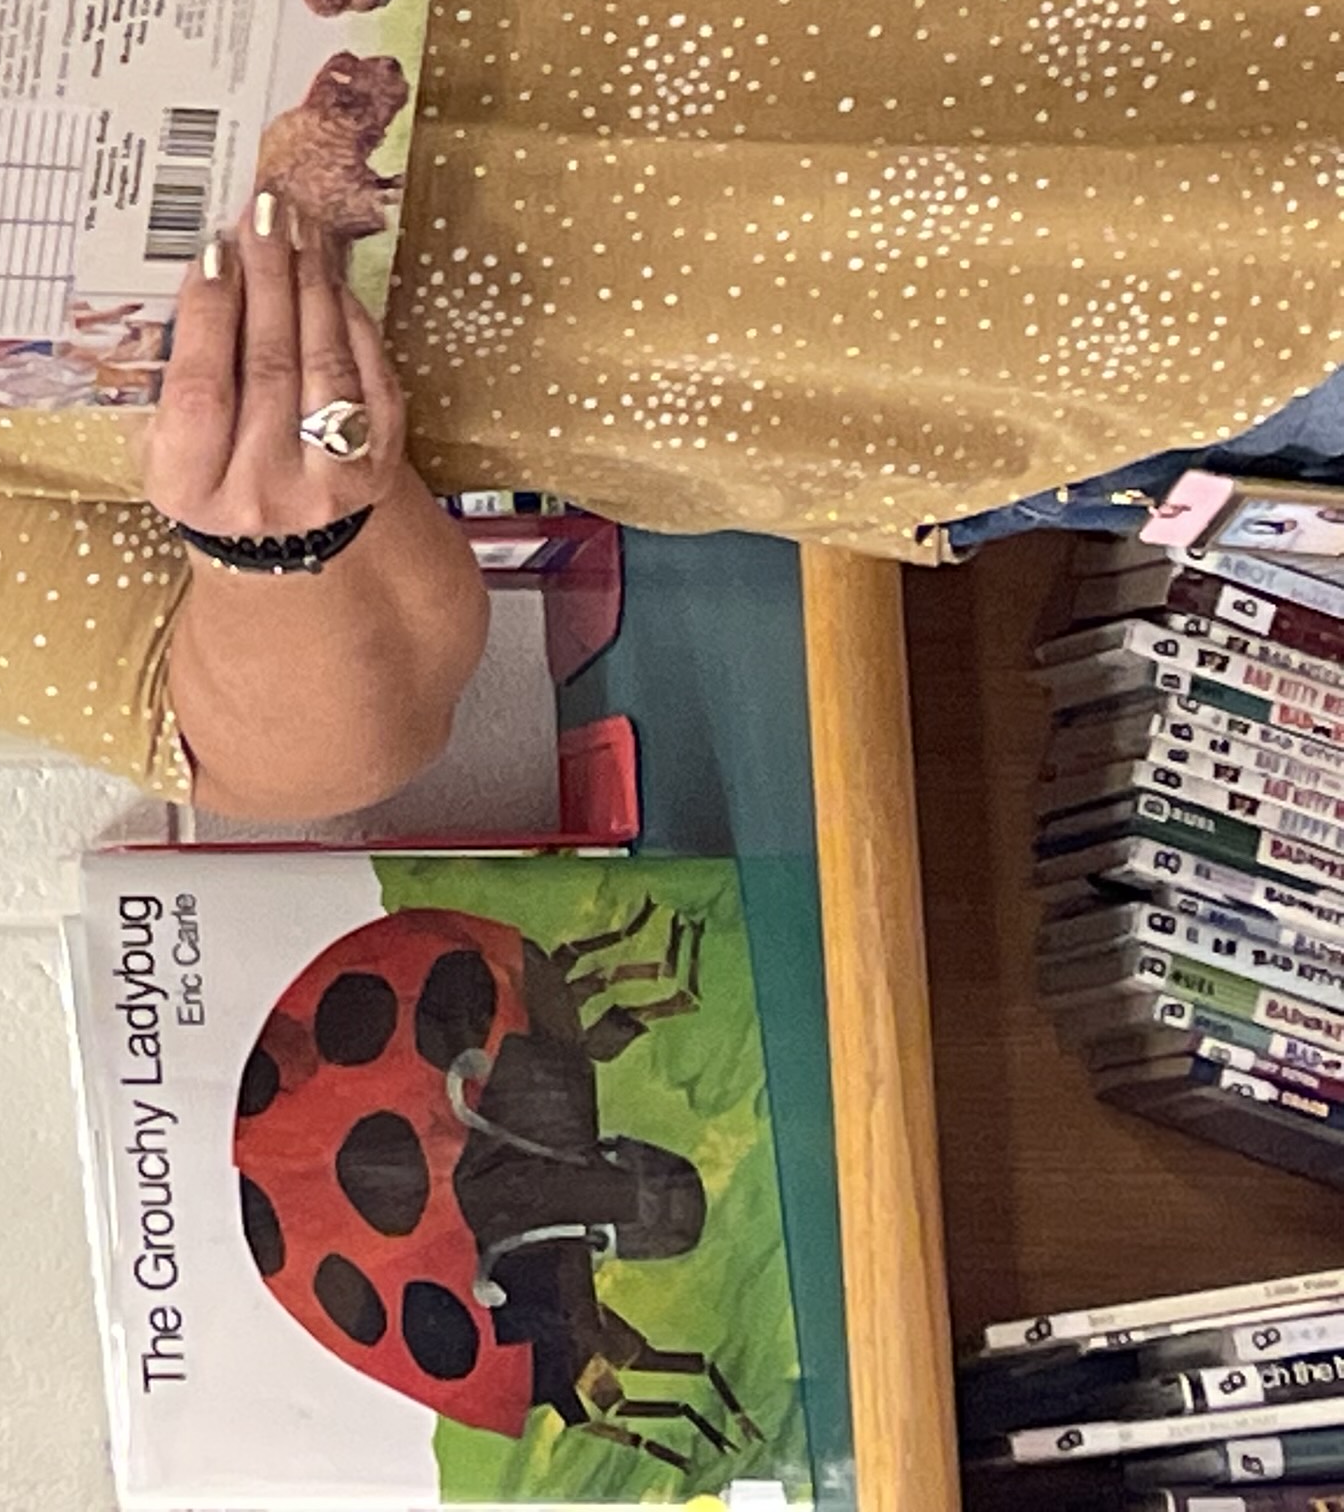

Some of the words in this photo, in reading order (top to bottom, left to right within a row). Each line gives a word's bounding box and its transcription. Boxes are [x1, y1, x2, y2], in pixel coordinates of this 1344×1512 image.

[1233, 599, 1257, 616] B
[172, 893, 201, 966] Carle
[111, 894, 165, 1086] Ladybug
[175, 974, 205, 1025] Eric
[128, 1101, 181, 1291] Grouchy
[141, 1307, 188, 1393] The
